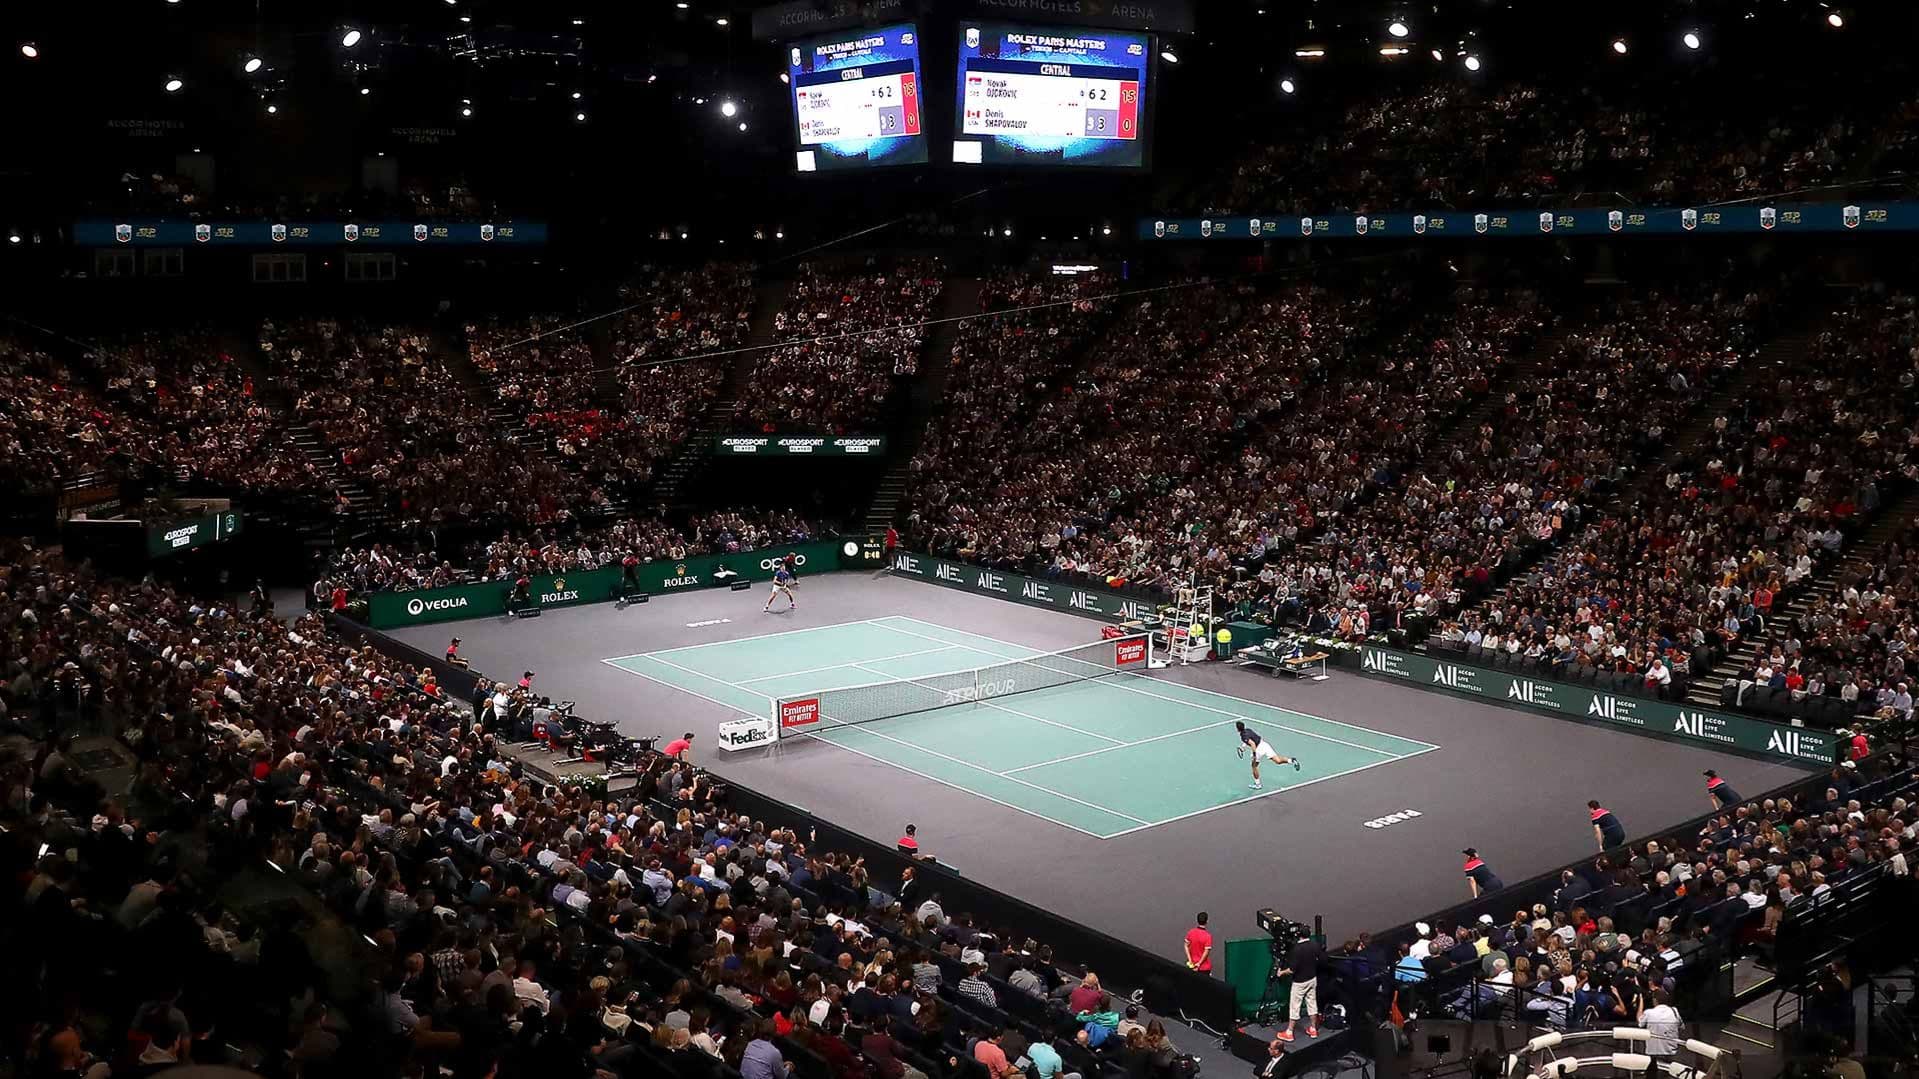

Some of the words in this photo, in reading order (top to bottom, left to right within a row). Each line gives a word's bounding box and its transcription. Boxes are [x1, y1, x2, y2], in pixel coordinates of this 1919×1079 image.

[1112, 5, 1155, 20] ARENA
[1007, 33, 1037, 45] ROLEX
[1066, 38, 1105, 50] MASTERS
[878, 87, 884, 98] 6
[886, 86, 892, 97] 2
[1089, 89, 1096, 100] 6
[1100, 89, 1107, 100] 2
[1122, 90, 1136, 103] 15
[1098, 116, 1106, 131] 3
[1122, 118, 1132, 131] 0
[725, 438, 768, 446] EUROSPORT
[781, 438, 824, 446] EUROSPORT
[760, 554, 806, 572] opo
[663, 575, 698, 588] ROLEX
[541, 590, 579, 603] ROLEX
[425, 598, 467, 611] VEOLIA
[1363, 649, 1386, 672] All
[1432, 664, 1457, 687] All
[978, 678, 1016, 699] TOUR
[1507, 679, 1534, 703] All
[783, 704, 816, 717] Emirates
[1587, 694, 1616, 720] All
[1616, 714, 1644, 725] LIMITLESS
[1673, 711, 1704, 737] All
[1704, 717, 1726, 726] ACCOR
[731, 728, 767, 746] FedEx
[1704, 732, 1735, 743] LIMITLESS
[1766, 729, 1800, 756] All
[1800, 736, 1824, 745] ACCOR
[1800, 743, 1815, 751] LIVE
[1800, 751, 1833, 763] LIMITLESS
